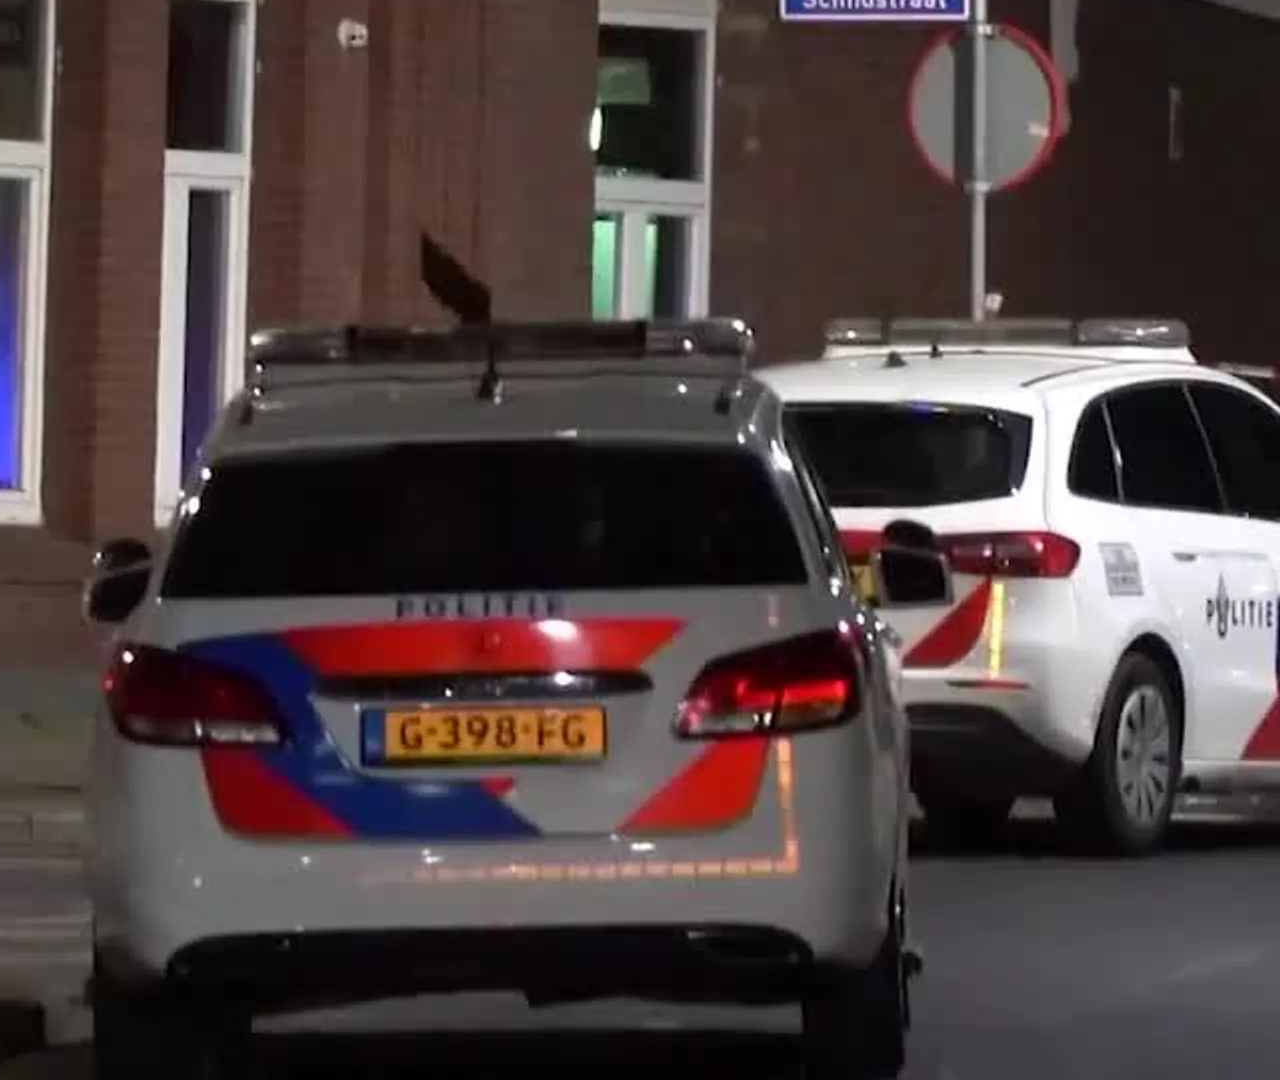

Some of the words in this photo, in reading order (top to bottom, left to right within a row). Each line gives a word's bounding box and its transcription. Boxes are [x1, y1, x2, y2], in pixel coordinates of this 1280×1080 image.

[396, 590, 563, 618] POLITIE
[1206, 596, 1273, 637] POLITIE
[399, 715, 587, 751] G-398-FG
